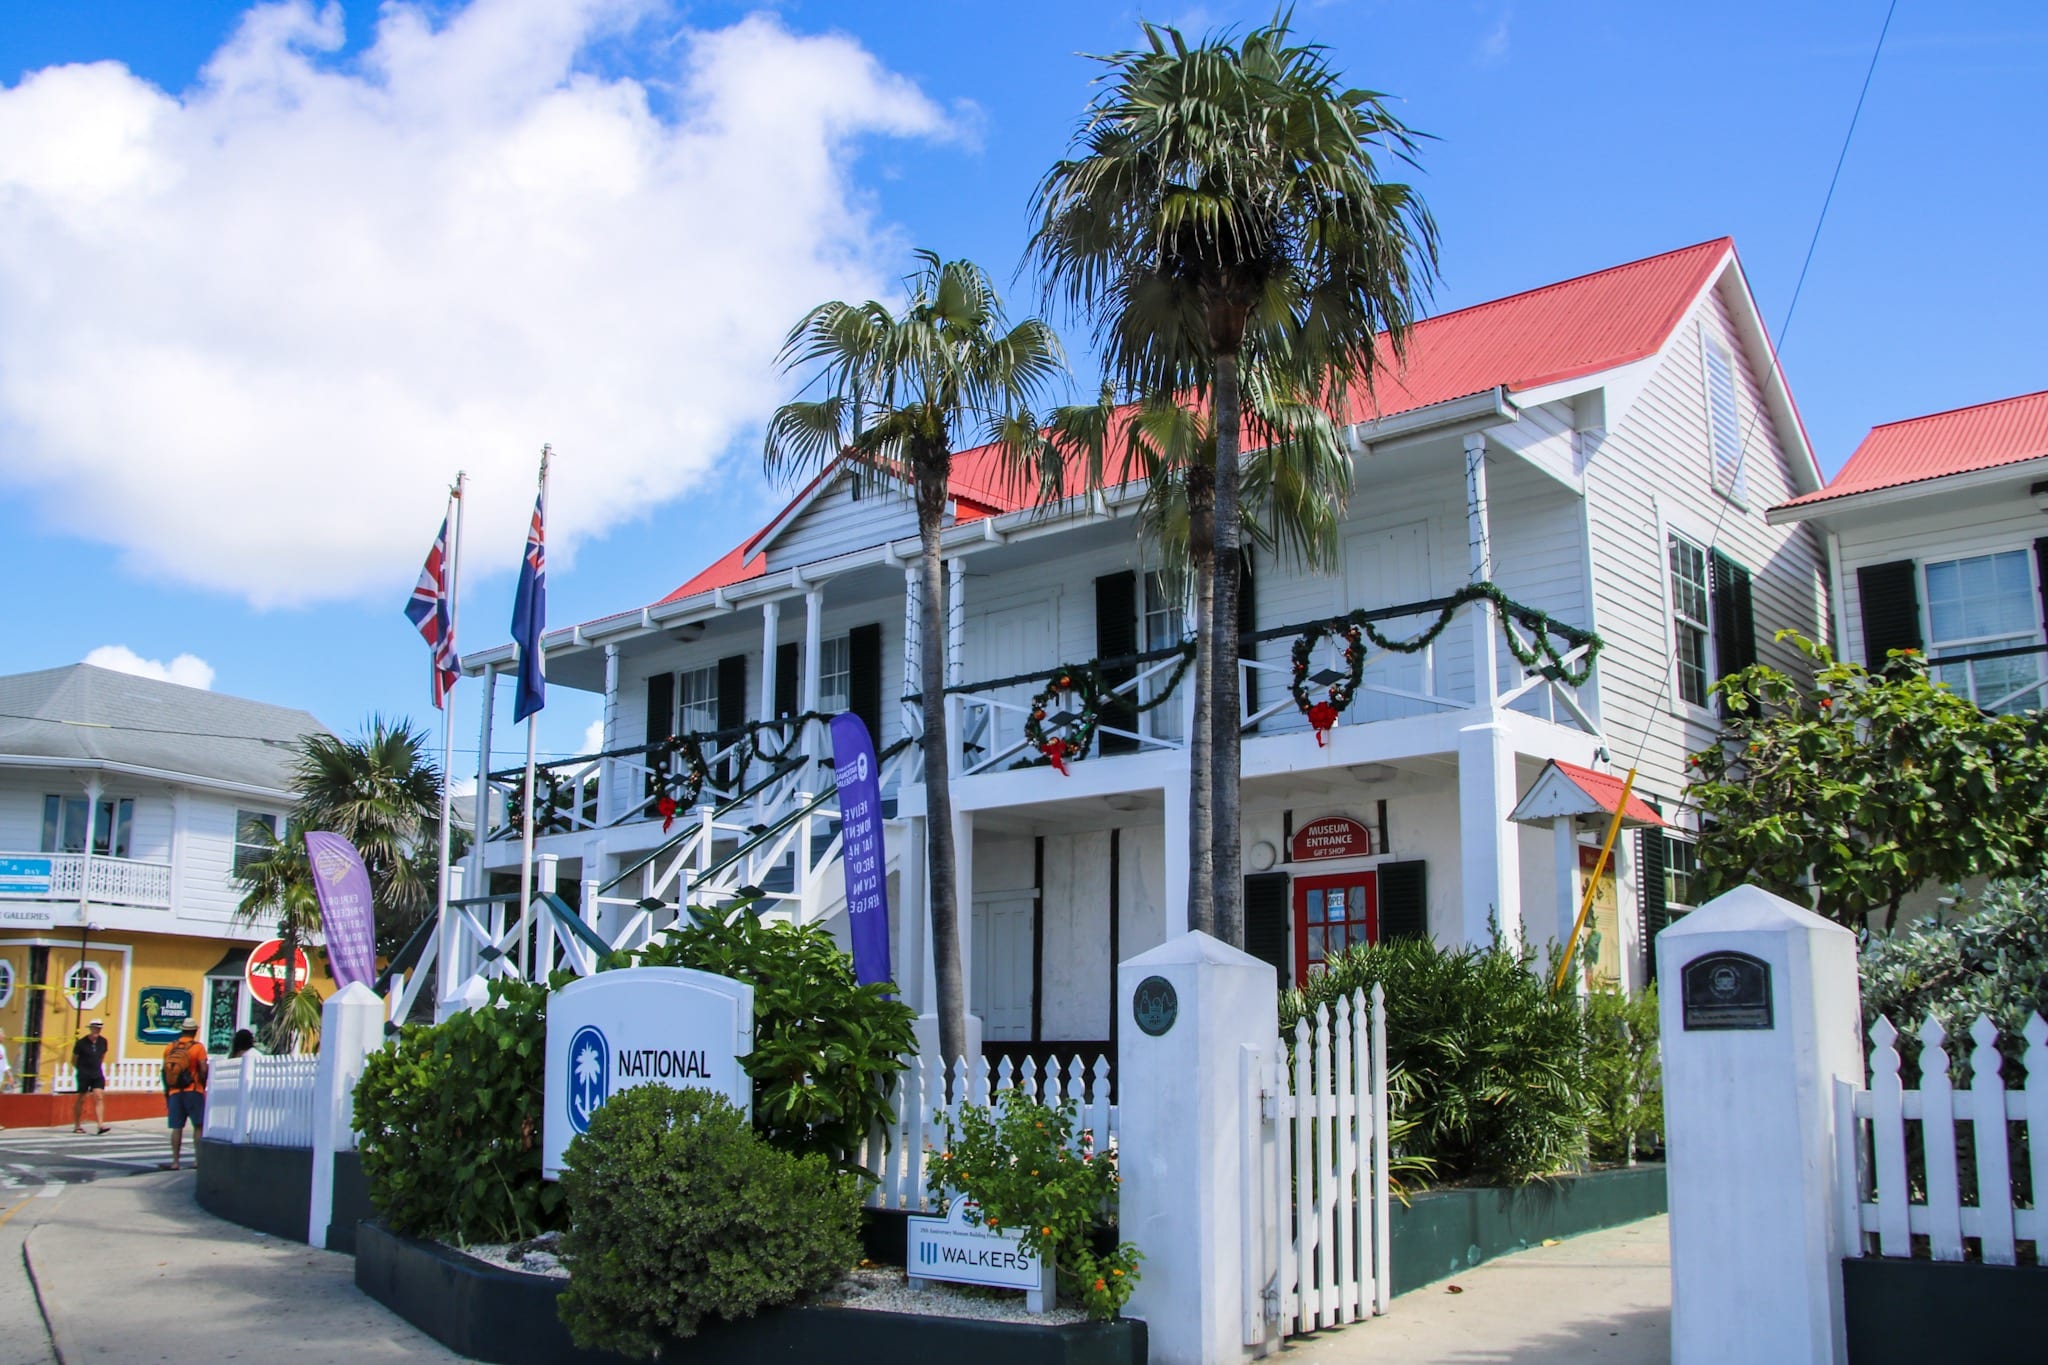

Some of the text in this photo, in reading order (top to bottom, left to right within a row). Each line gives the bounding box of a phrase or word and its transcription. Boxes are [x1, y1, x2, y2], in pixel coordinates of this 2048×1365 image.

[1309, 823, 1349, 836] MUSEUM
[1306, 834, 1352, 847] ENTRANCE
[1328, 847, 1345, 855] SHOP
[3, 912, 50, 920] GALLERIES
[165, 999, 184, 1009] Island
[160, 1006, 187, 1017] Treasures
[618, 1050, 711, 1078] NATIONAL
[942, 1246, 1029, 1270] WALKERS
